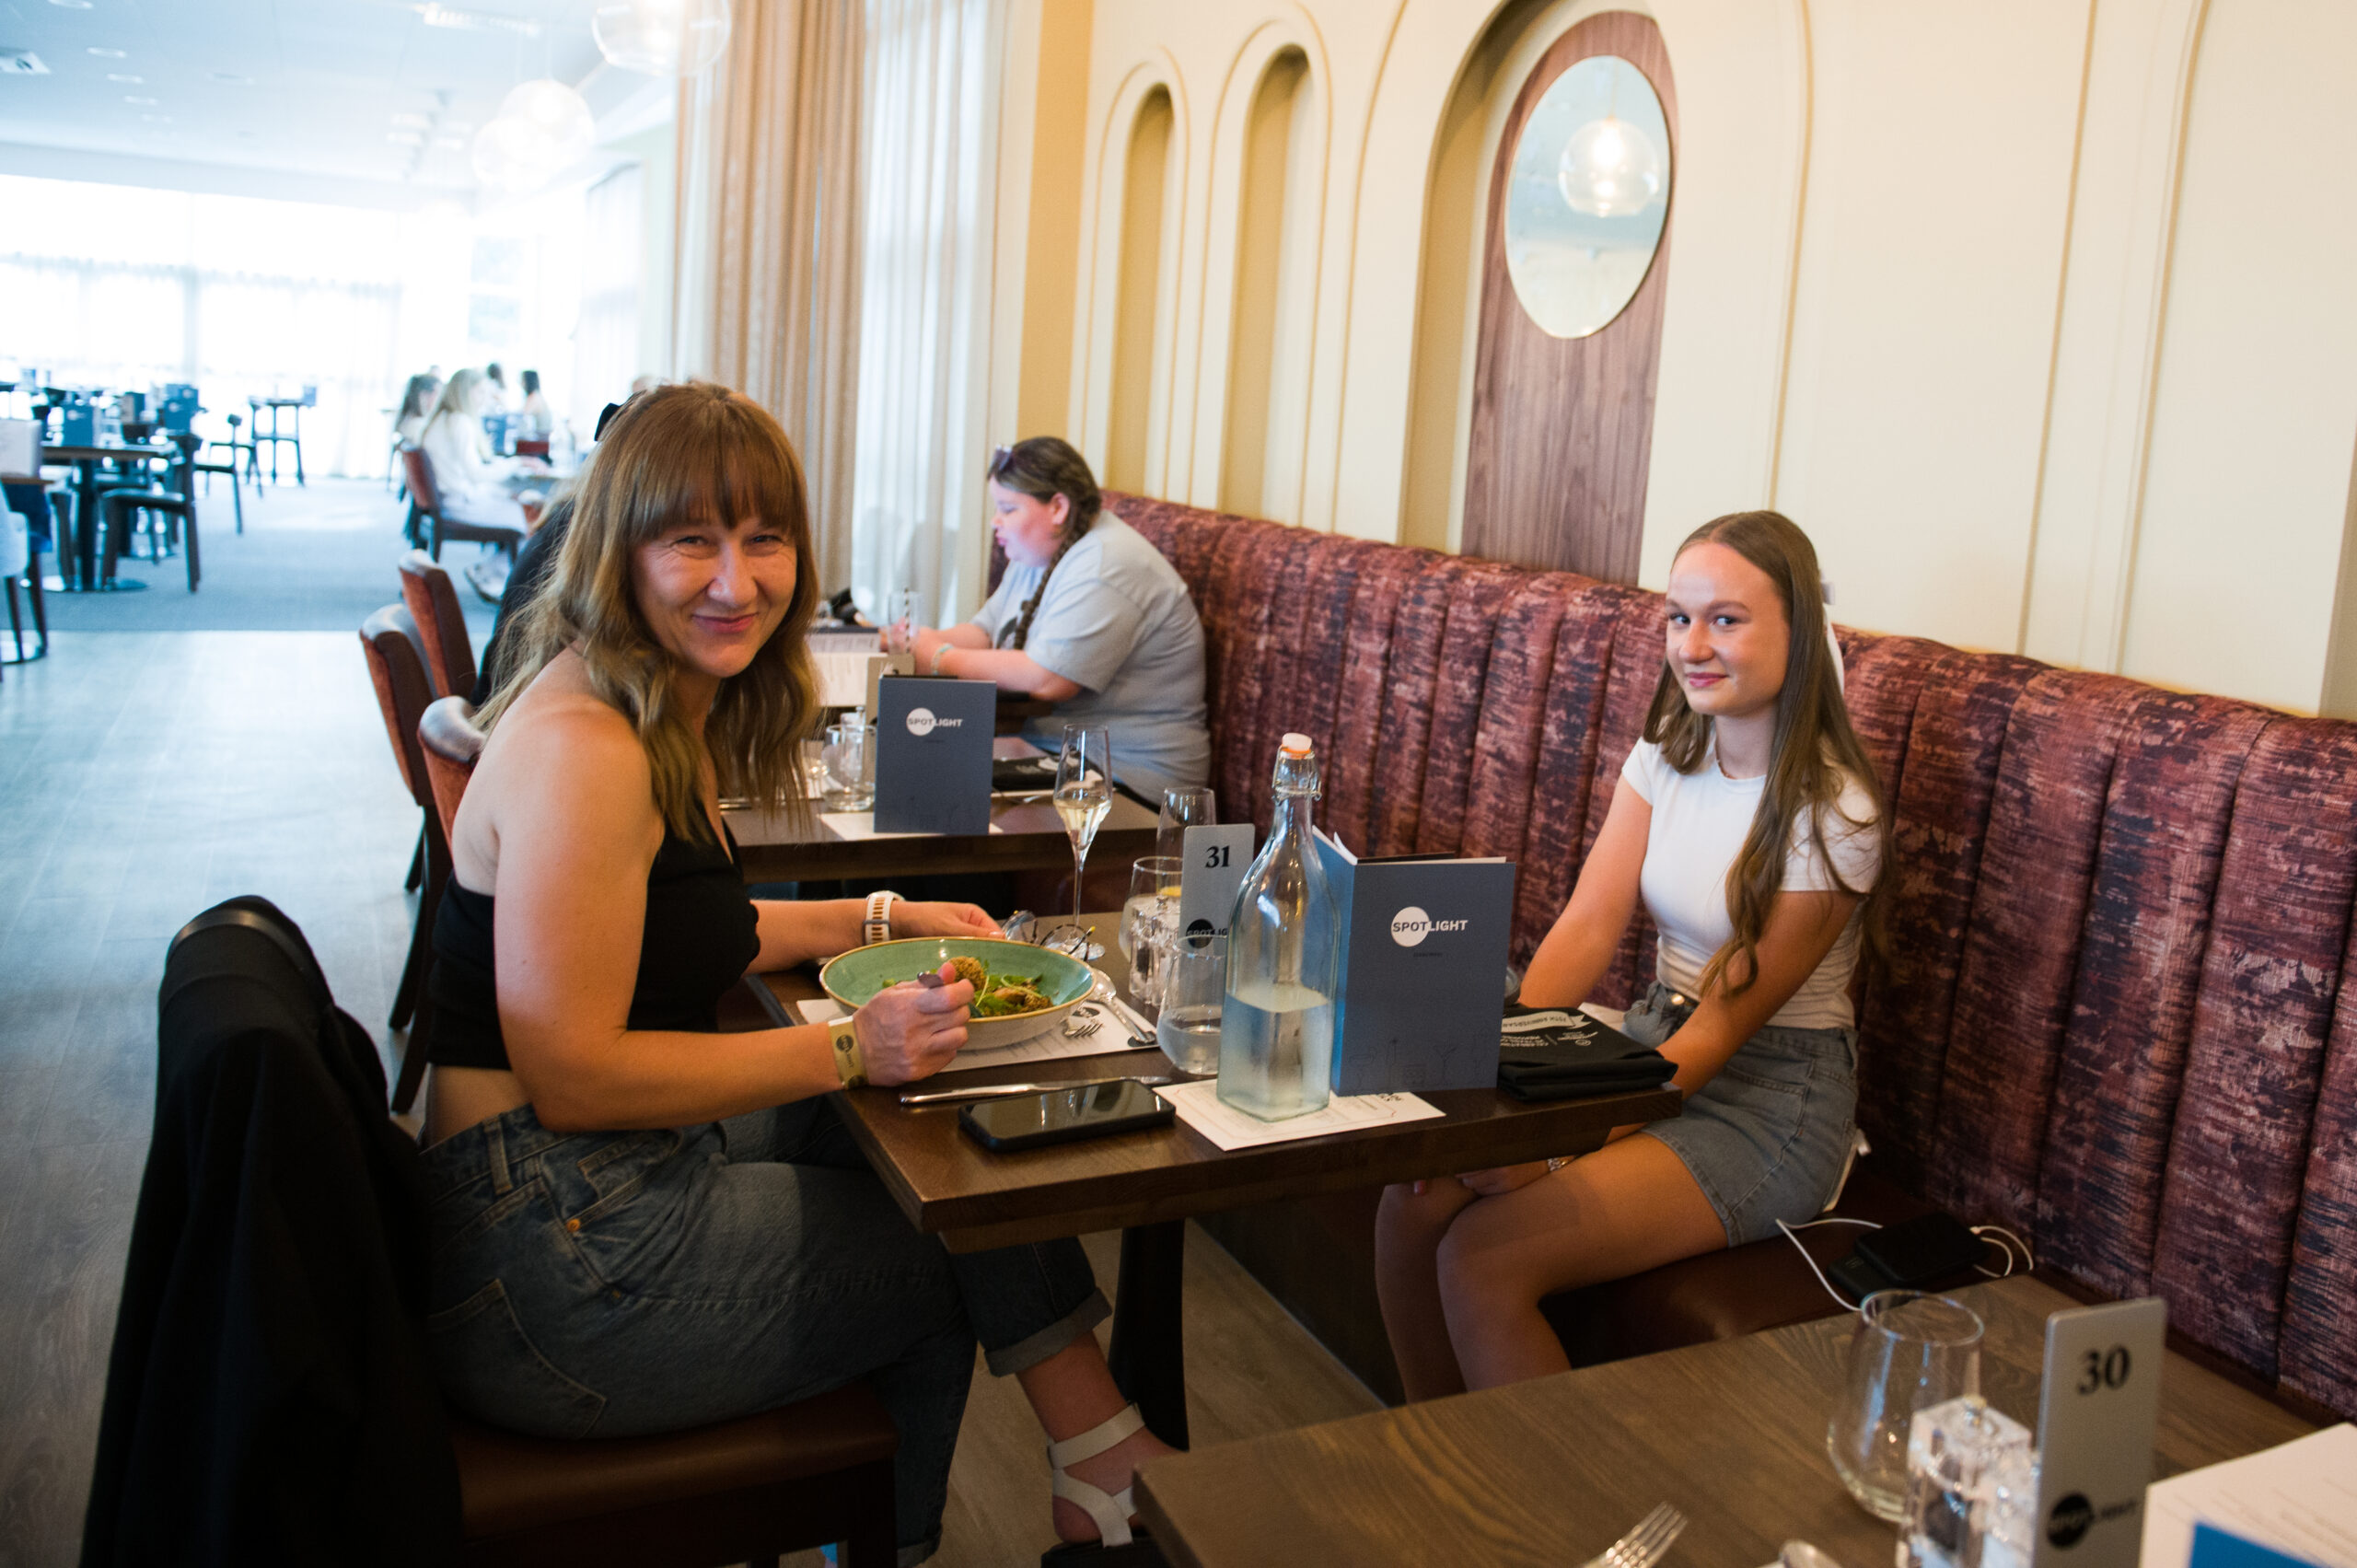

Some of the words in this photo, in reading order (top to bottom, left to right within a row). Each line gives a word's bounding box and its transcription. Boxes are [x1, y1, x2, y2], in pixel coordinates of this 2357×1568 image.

[908, 718, 963, 727] SPOTLIGHT
[1204, 845, 1231, 868] 31
[1392, 920, 1469, 933] SPOTLIGHT
[2077, 1343, 2131, 1396] 30
